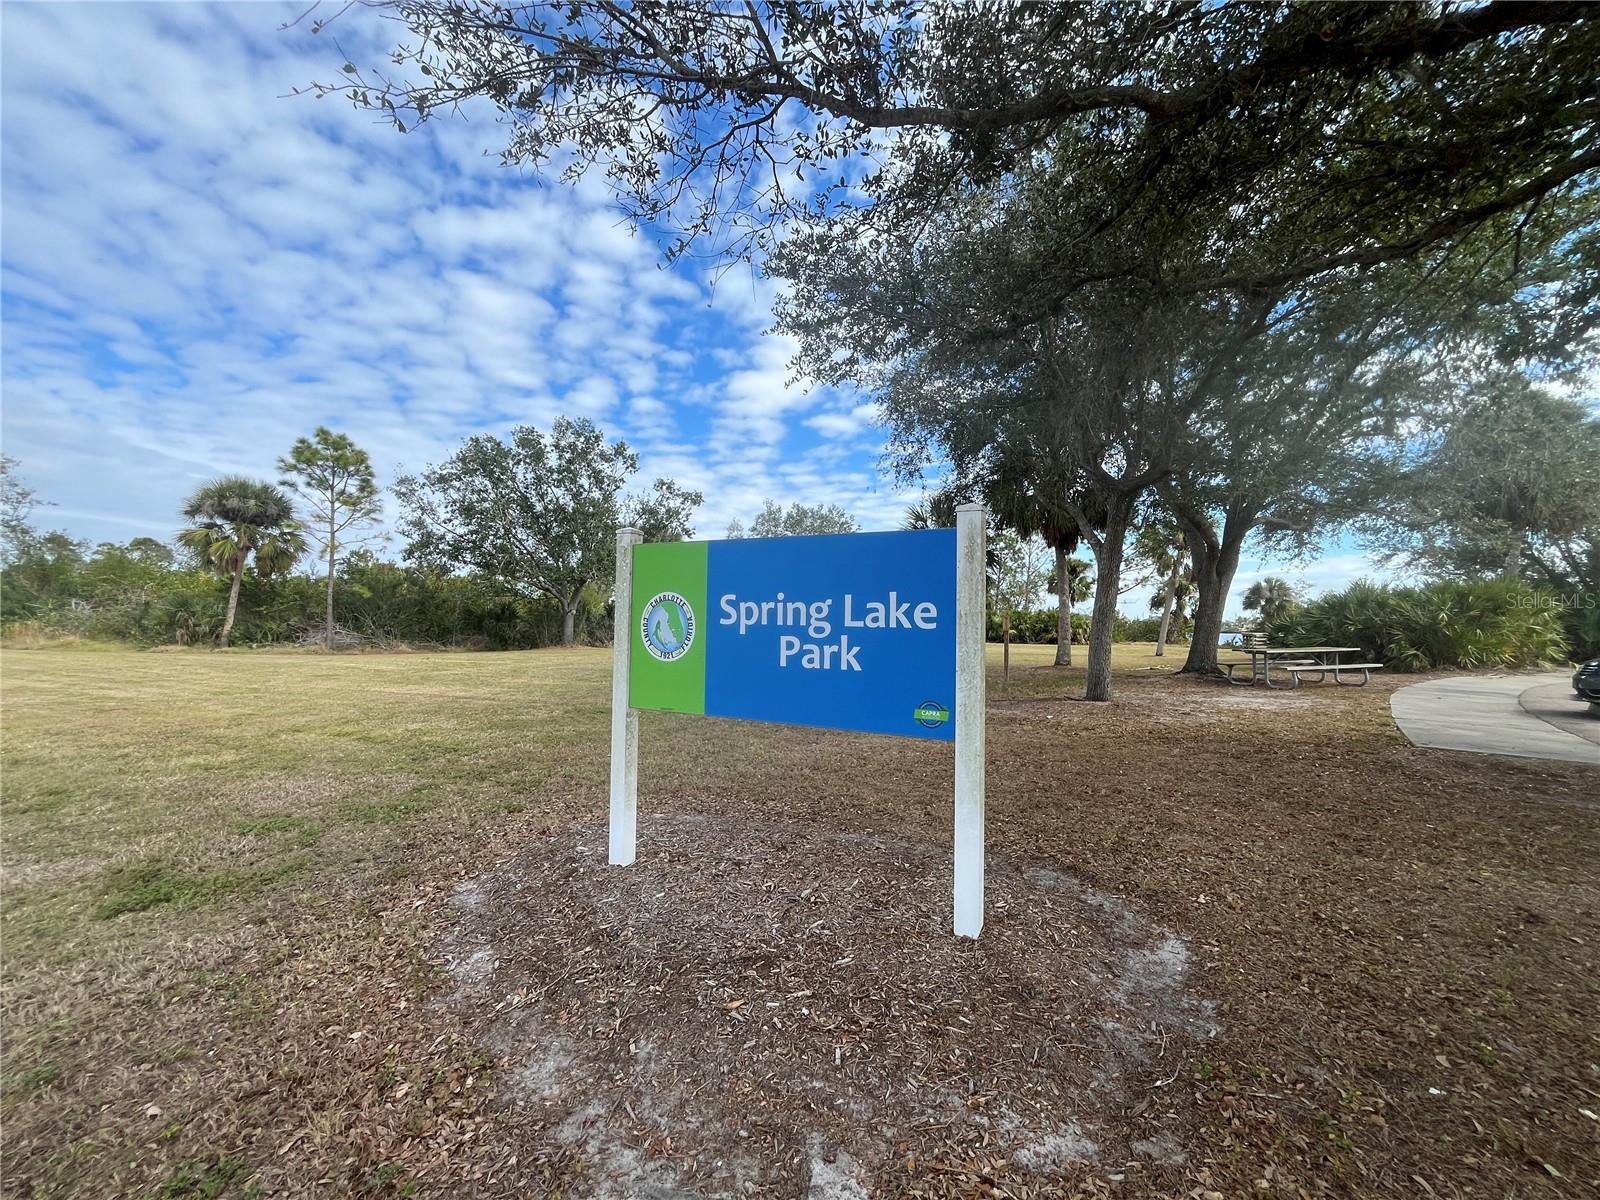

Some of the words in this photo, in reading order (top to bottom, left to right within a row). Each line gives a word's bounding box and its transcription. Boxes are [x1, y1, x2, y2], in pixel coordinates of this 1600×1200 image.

[650, 594, 686, 609] CHARLOTTE
[719, 592, 832, 638] Spring
[844, 591, 938, 629] Lake
[642, 617, 653, 647] COUNTY
[681, 616, 694, 651] FLORIDA
[779, 634, 862, 671] Park
